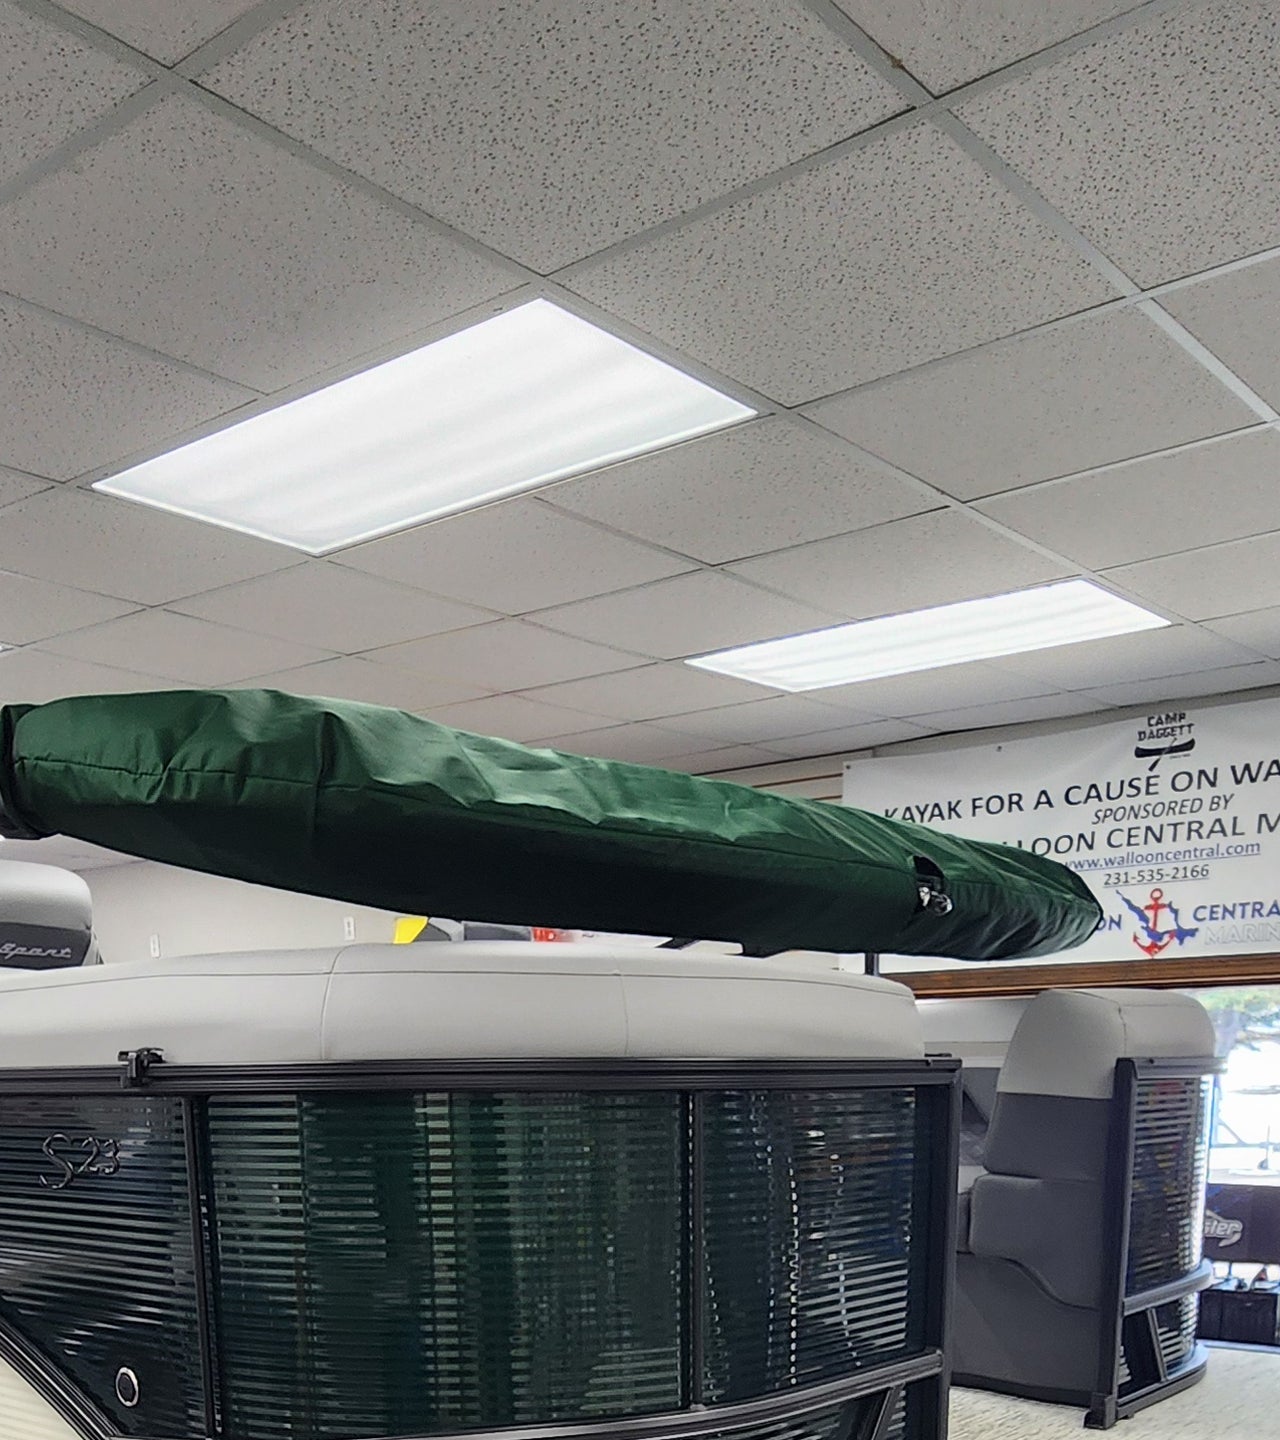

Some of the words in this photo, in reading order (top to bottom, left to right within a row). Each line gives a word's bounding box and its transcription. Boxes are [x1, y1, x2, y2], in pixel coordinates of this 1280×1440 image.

[1137, 723, 1195, 741] DAGGETT
[1147, 712, 1186, 727] CAMP
[972, 793, 1024, 817] FOR
[1033, 790, 1054, 810] A
[1064, 775, 1160, 805] CAUSE
[1171, 767, 1218, 792] ON
[1091, 797, 1203, 825] SPONSORED
[1209, 793, 1235, 812] BY
[1106, 816, 1246, 848] CENTRAL
[1103, 864, 1210, 886] 231-535-2166
